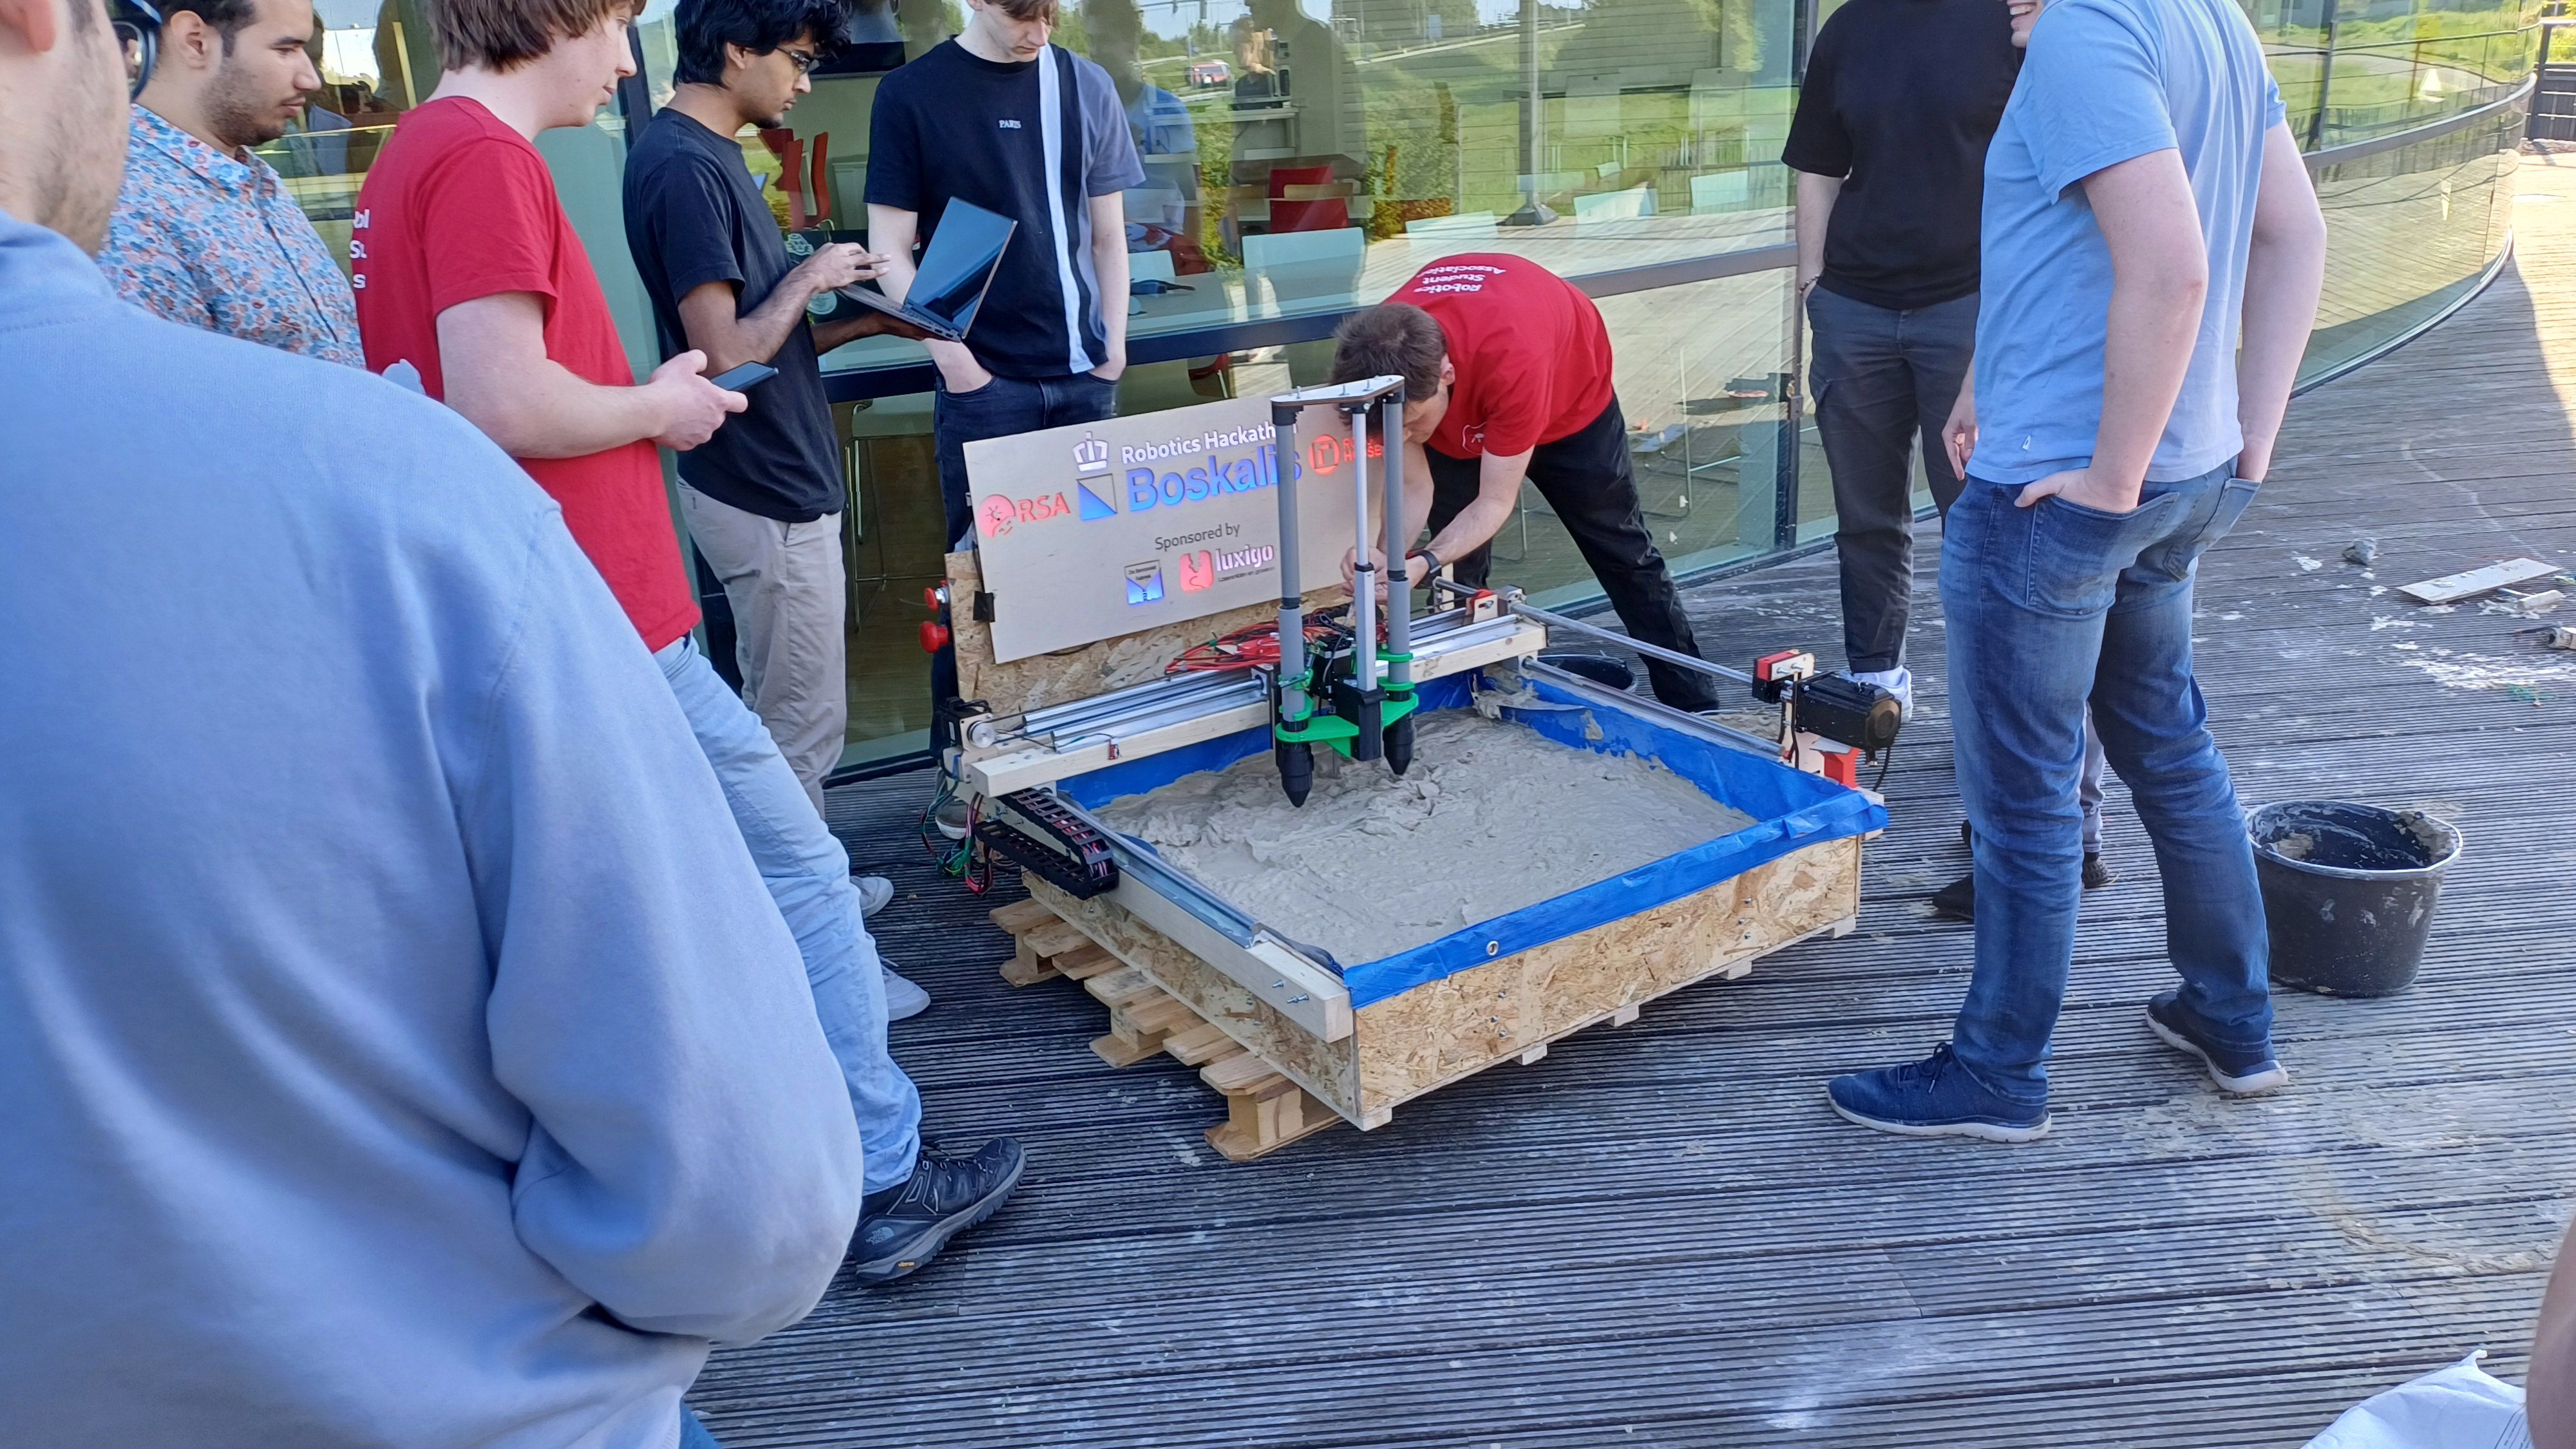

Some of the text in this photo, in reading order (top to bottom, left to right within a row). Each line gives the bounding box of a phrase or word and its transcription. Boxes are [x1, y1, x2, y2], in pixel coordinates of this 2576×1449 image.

[999, 119, 1021, 129] PARIS
[1422, 274, 1486, 284] Student
[1122, 421, 1298, 464] Robotics Hackath
[1017, 491, 1070, 523] RSA
[1155, 522, 1240, 552] Sponsored by
[1215, 544, 1273, 571] luxigo
